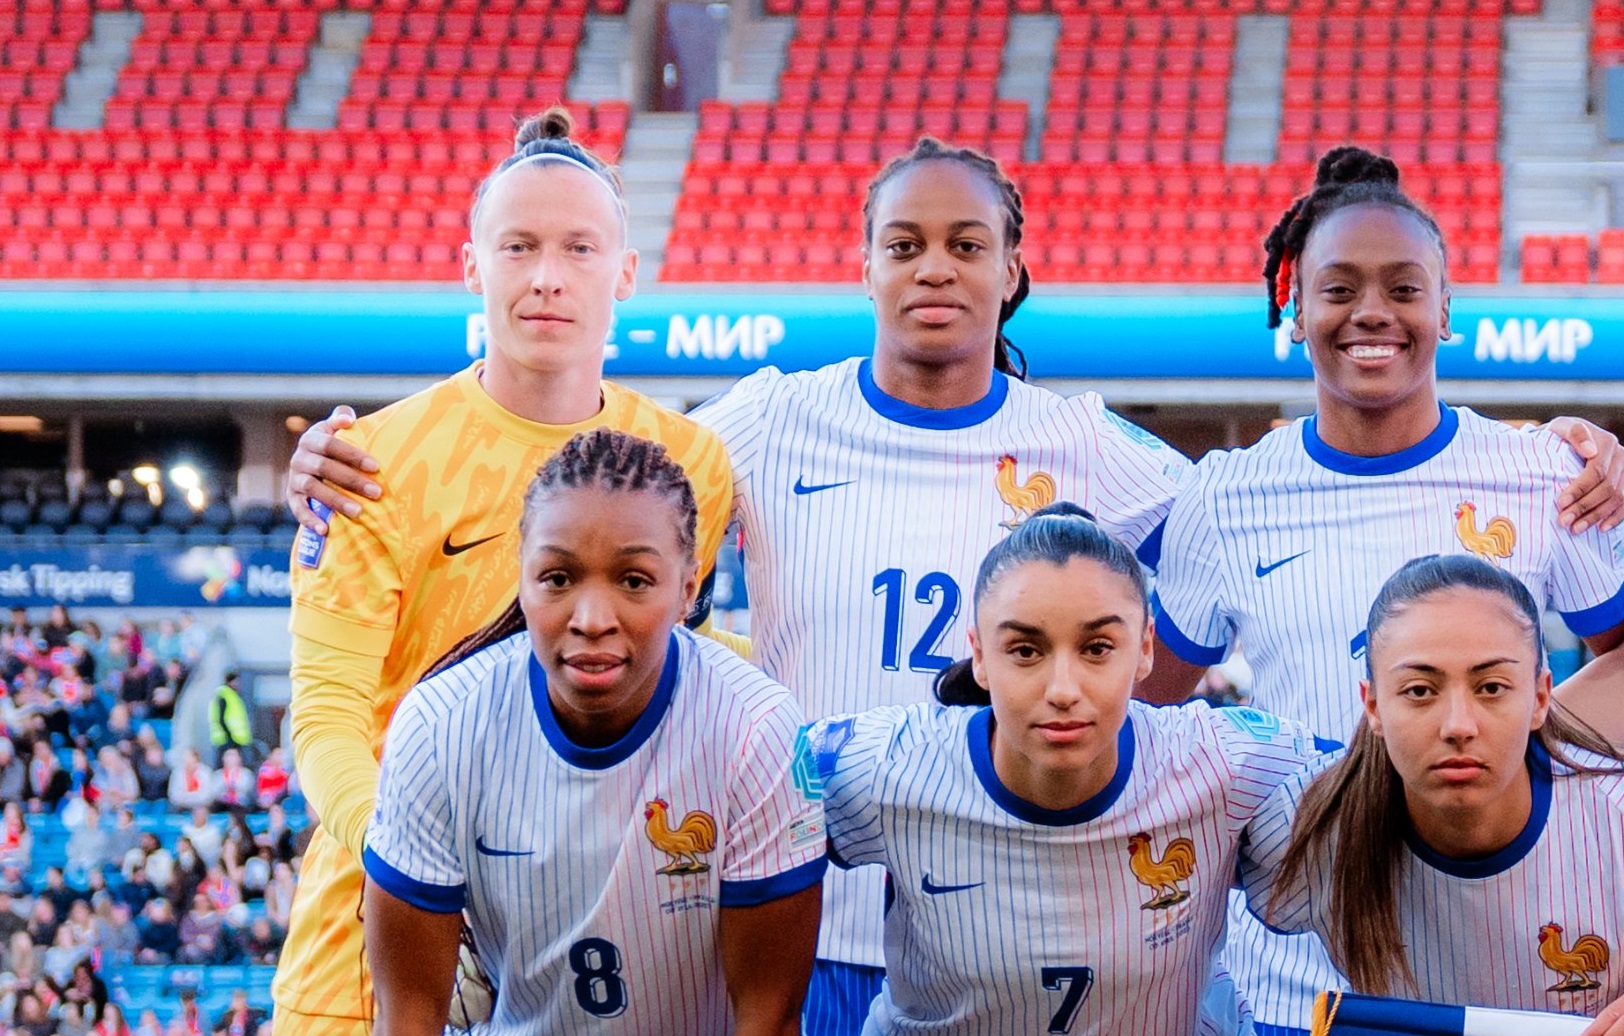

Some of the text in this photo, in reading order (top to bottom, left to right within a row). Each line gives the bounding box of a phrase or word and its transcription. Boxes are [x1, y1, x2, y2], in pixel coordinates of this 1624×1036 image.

[666, 314, 786, 360] МИР
[1474, 317, 1593, 363] МИР
[31, 563, 135, 604] Tipping
[873, 568, 962, 673] 12
[568, 937, 628, 1019] 8
[1040, 966, 1094, 1035] 7
